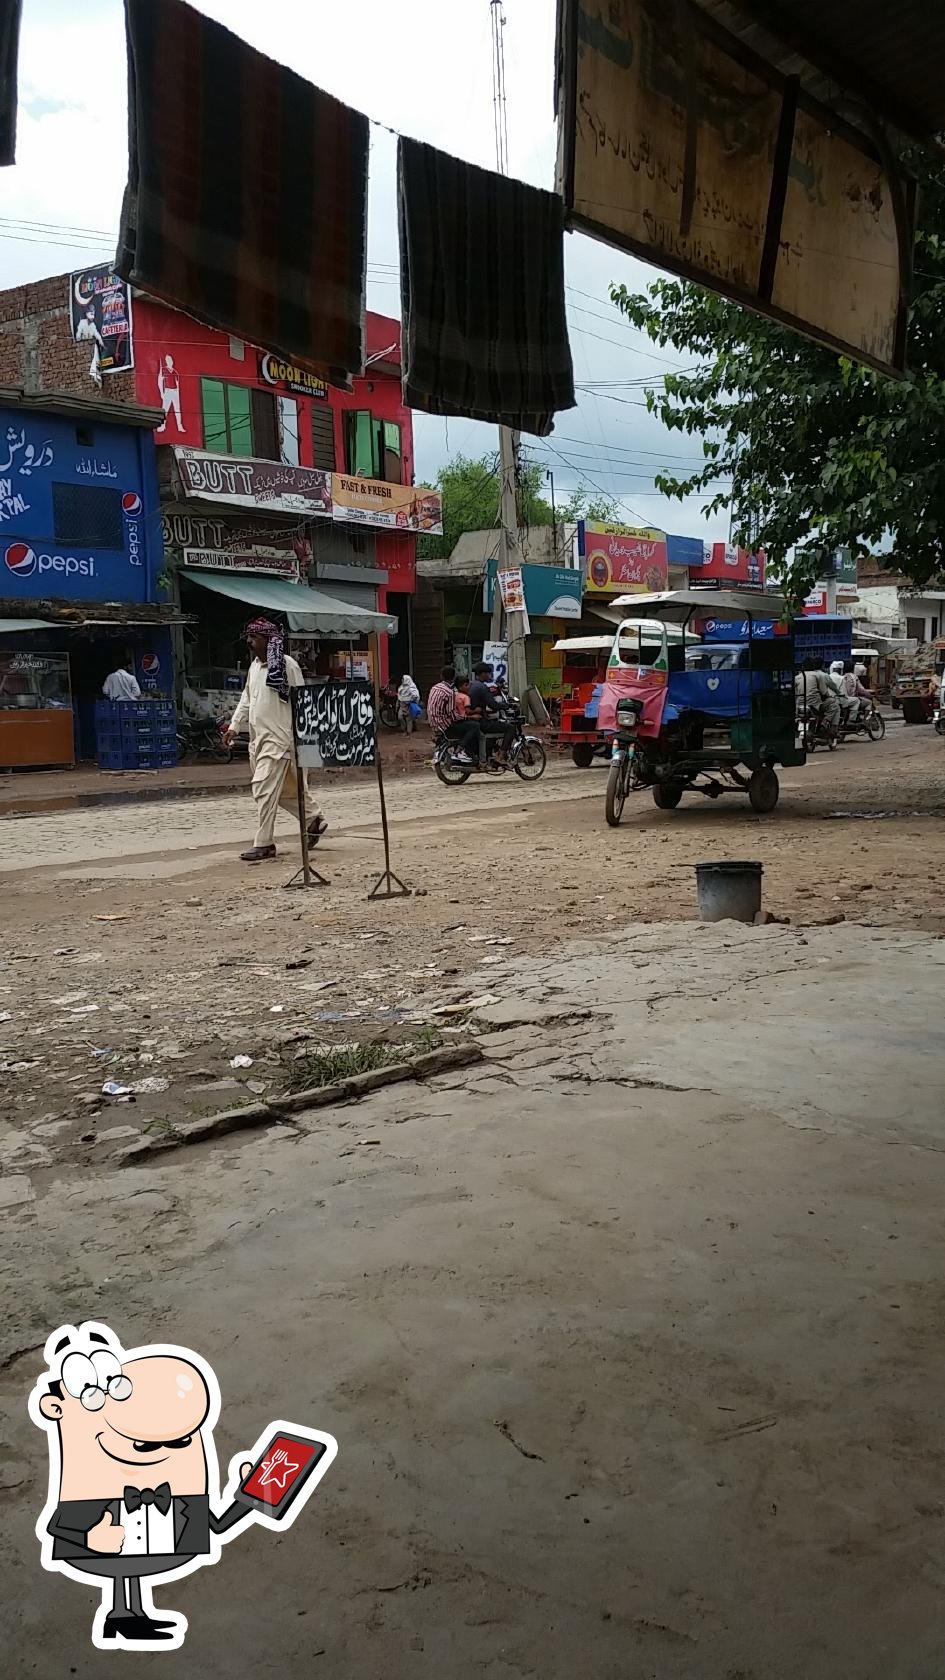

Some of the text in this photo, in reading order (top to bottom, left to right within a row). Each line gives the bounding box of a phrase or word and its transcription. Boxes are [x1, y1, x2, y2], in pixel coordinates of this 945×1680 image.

[102, 322, 128, 336] CAFETERIA
[269, 361, 301, 384] MOON
[312, 387, 325, 397] CLUB
[185, 459, 254, 494] BUTT
[340, 480, 360, 494] FAST
[360, 483, 367, 495] &
[367, 485, 392, 499] FRESH
[125, 519, 142, 566] pepsi
[38, 554, 94, 577] pepsi
[200, 552, 235, 568] BUTT
[339, 689, 373, 733] وقاص
